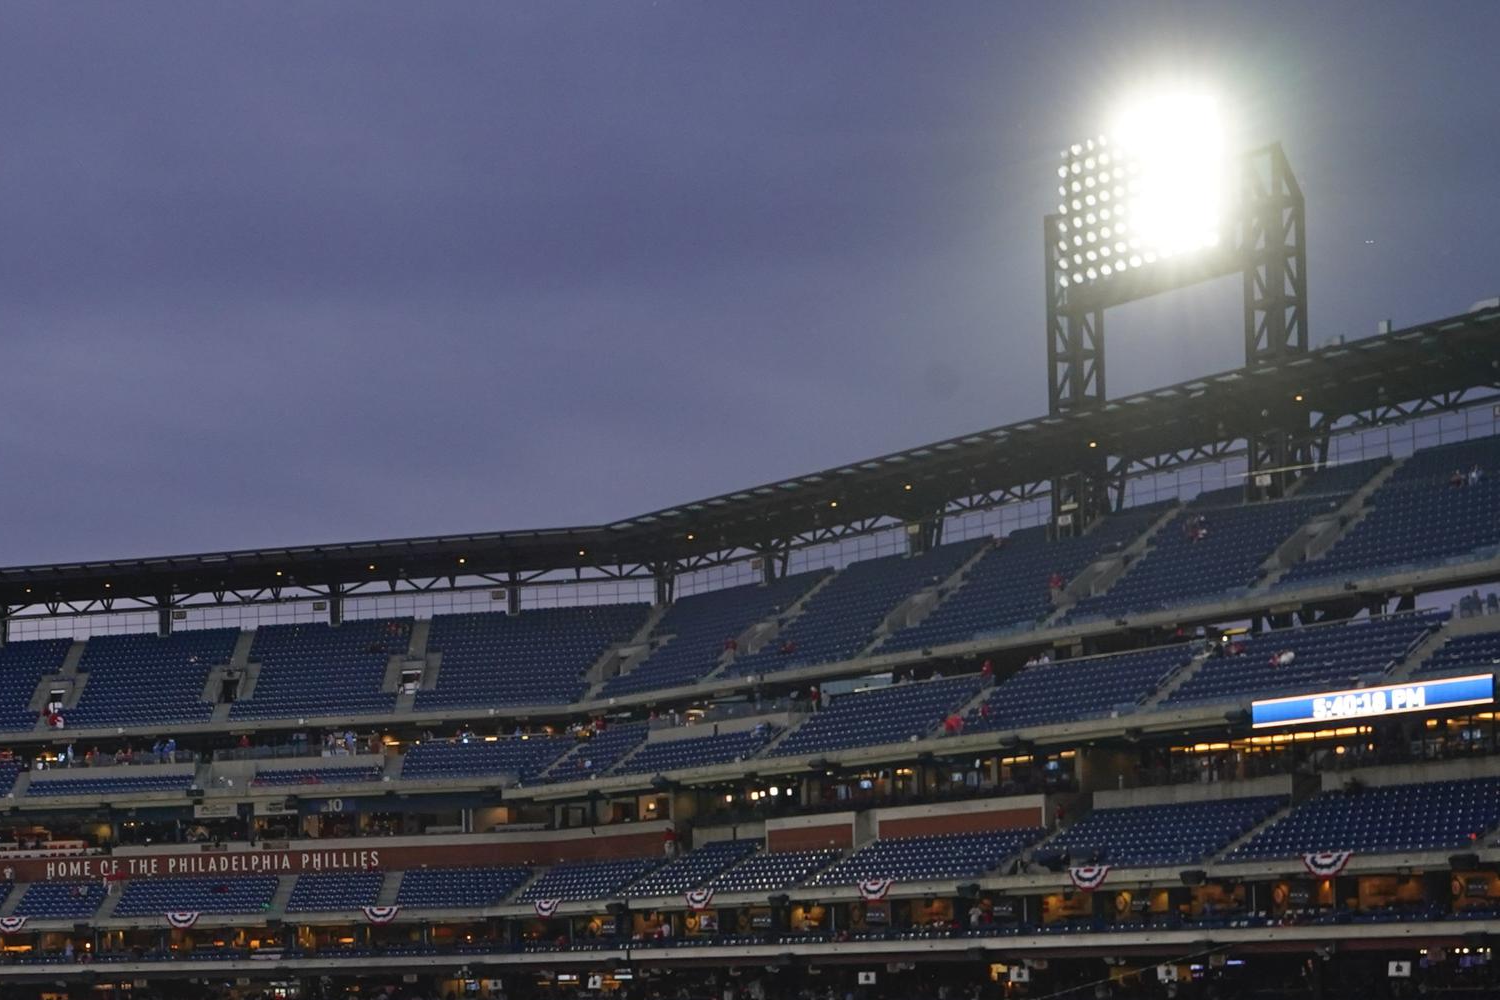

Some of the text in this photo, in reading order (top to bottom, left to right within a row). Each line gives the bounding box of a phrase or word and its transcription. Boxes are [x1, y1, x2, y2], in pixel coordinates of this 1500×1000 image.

[1313, 687, 1426, 718] 5:40:18 PM
[46, 851, 379, 877] HOME OF THE PHILADELPHIA PHILLIES
